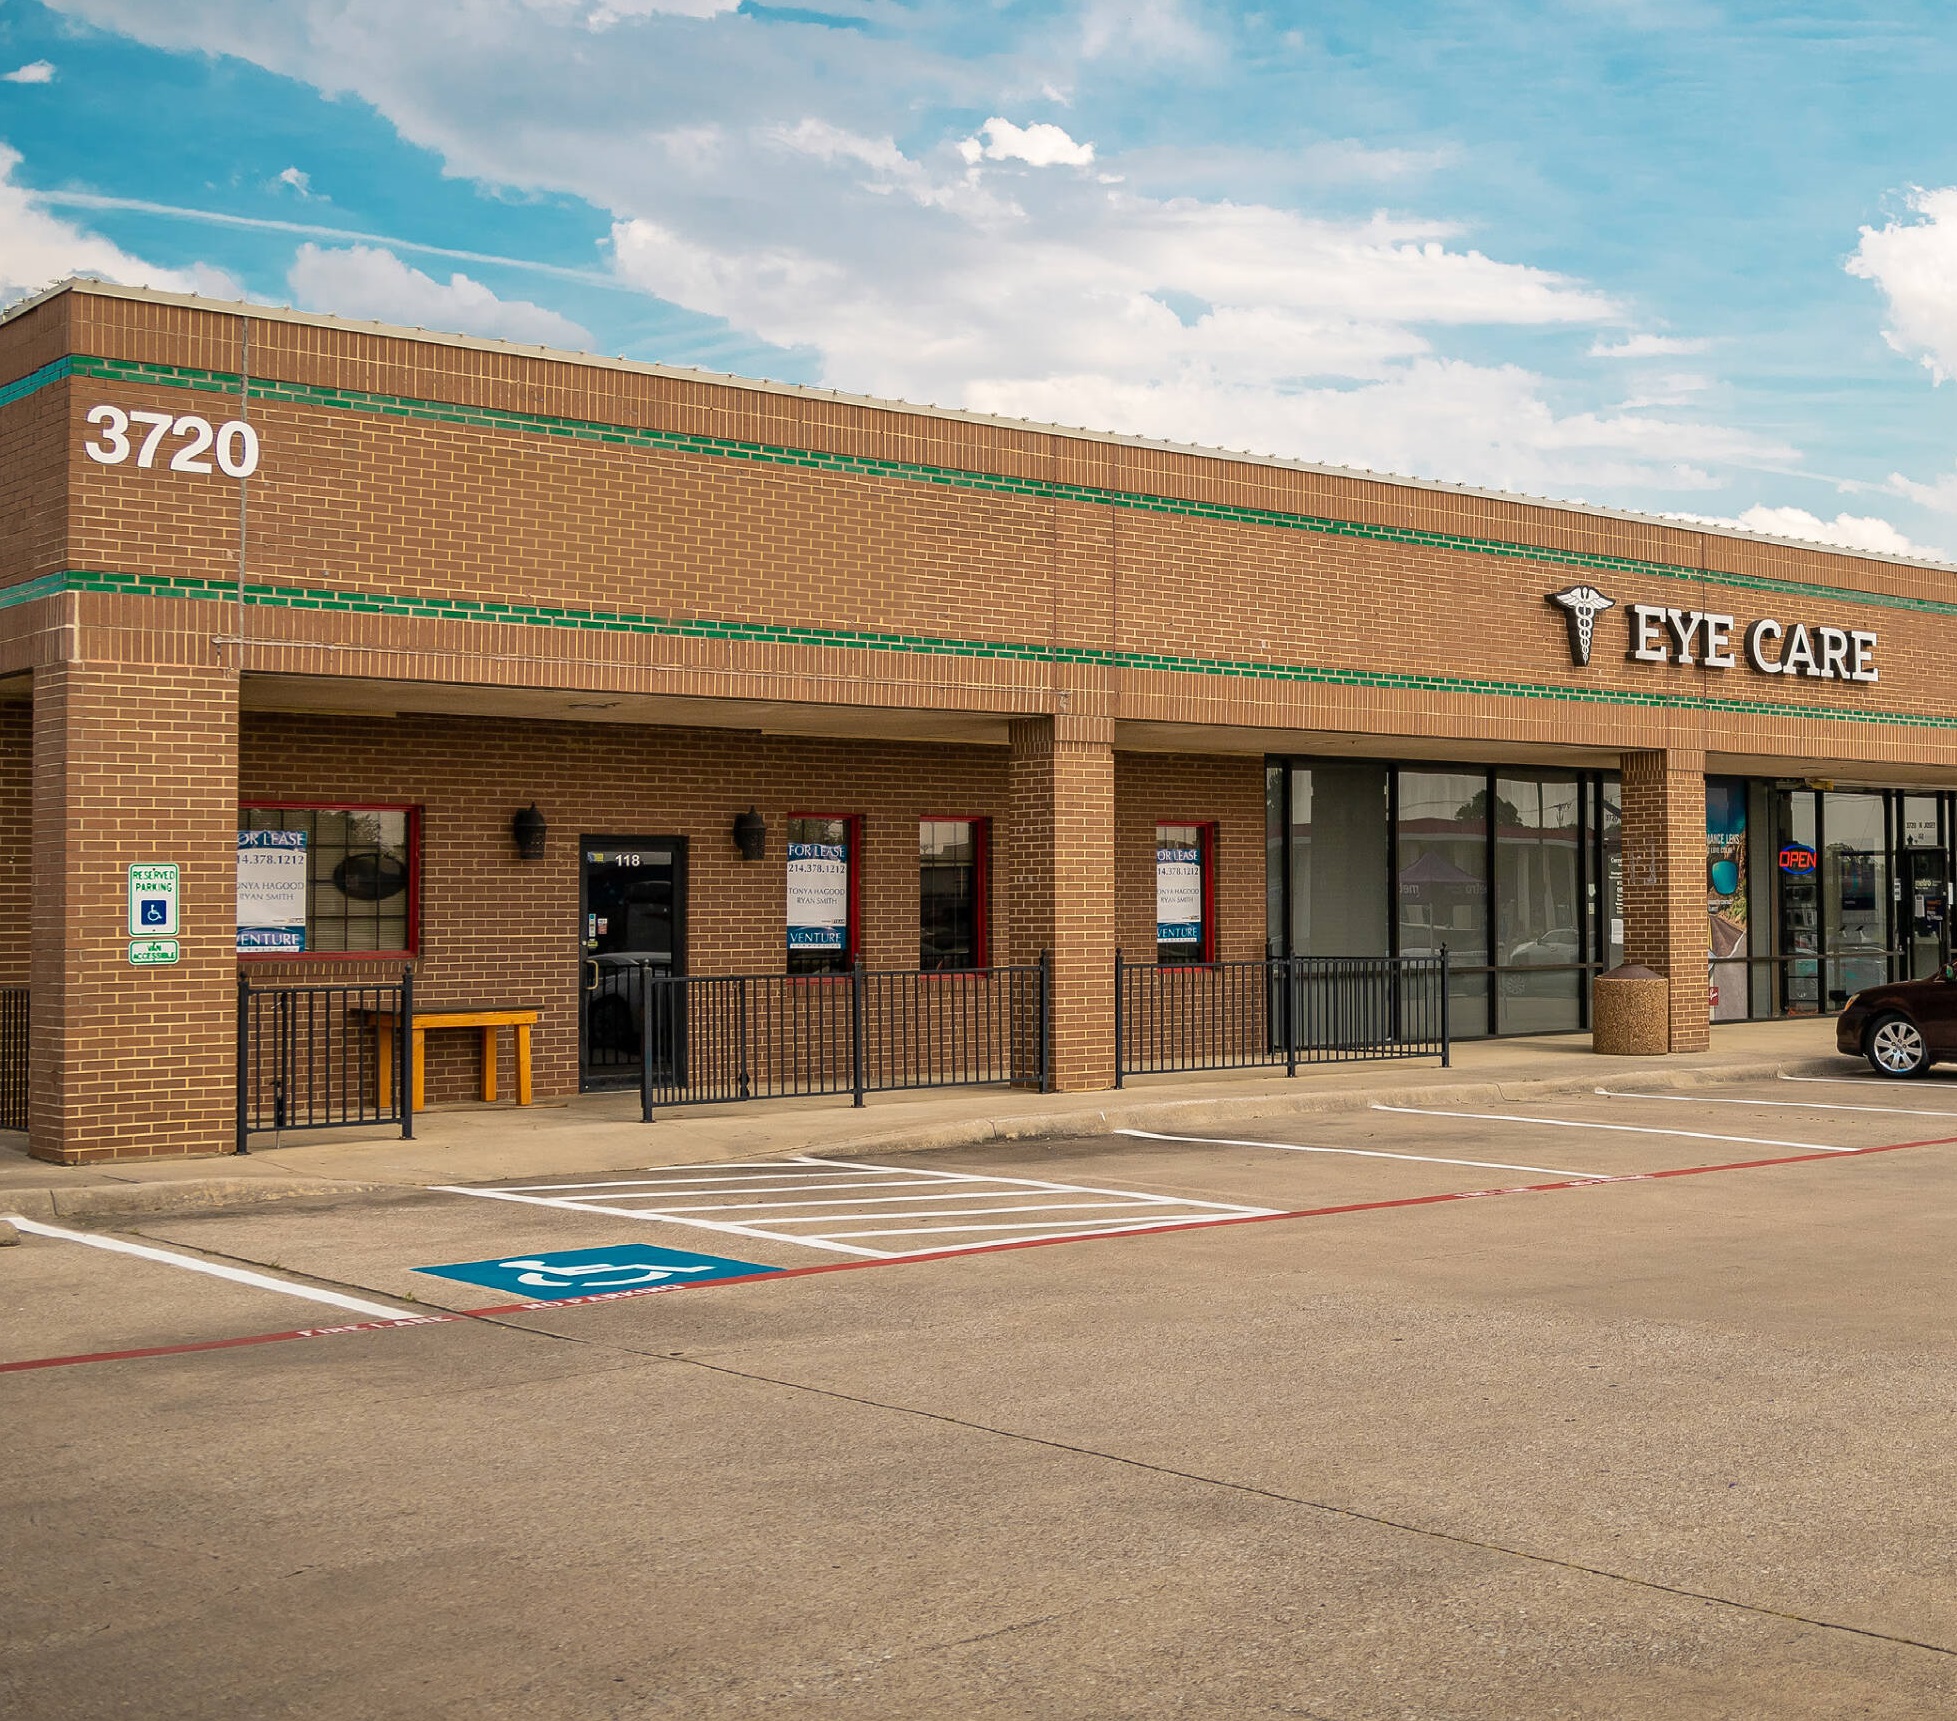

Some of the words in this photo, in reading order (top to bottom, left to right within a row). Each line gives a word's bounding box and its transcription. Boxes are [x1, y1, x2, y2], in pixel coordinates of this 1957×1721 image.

[84, 405, 259, 478] 3720
[1628, 604, 1735, 668] EYE
[1746, 618, 1879, 682] CARE
[237, 833, 259, 846] OR
[263, 833, 304, 846] LEASE
[788, 845, 812, 857] FOR
[814, 846, 845, 858] LEASE
[1157, 850, 1172, 861] OR
[1173, 850, 1198, 861] LEASE
[237, 854, 304, 865] 14.378.1212
[615, 854, 640, 867] 118
[1779, 851, 1817, 868] OPEN
[788, 864, 845, 874] 214.378.1212
[1157, 867, 1199, 876] 14.378.1212
[132, 870, 175, 880] RESERVED
[135, 883, 172, 892] PARKING
[236, 881, 259, 890] NYA
[262, 881, 304, 891] HAGOOD
[788, 887, 813, 895] TONYA
[265, 893, 294, 901] SMITH
[797, 896, 815, 904] RYAN
[816, 896, 838, 905] SMITH
[1157, 926, 1198, 938] VENTURE
[789, 932, 841, 944] VENTURE
[521, 1300, 564, 1310] NO
[565, 1284, 686, 1304] PARKING
[297, 1325, 368, 1337] FIRE
[370, 1316, 452, 1329] LANE
